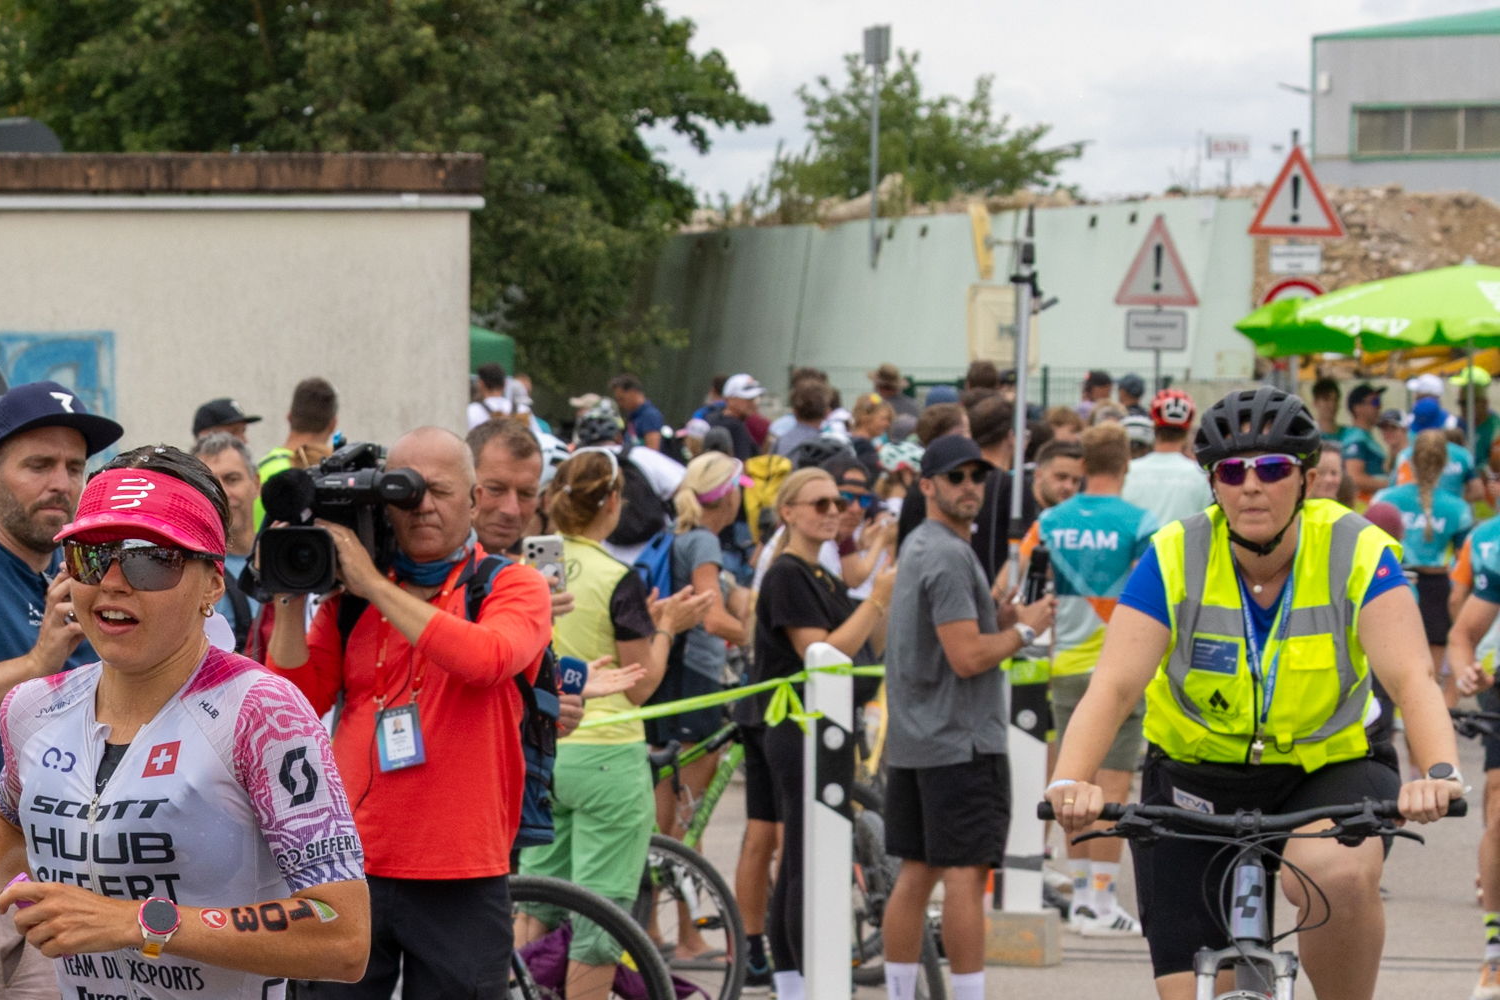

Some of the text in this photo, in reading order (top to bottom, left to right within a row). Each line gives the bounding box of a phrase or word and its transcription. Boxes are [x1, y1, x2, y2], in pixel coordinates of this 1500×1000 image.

[1401, 511, 1447, 534] EAM
[1051, 528, 1119, 551] TEAM
[563, 668, 583, 688] BR
[30, 794, 170, 822] SCOTT
[30, 823, 176, 865] HUUB
[305, 834, 358, 860] SIFFERT
[230, 899, 316, 933] 103
[62, 953, 99, 979] TEAM
